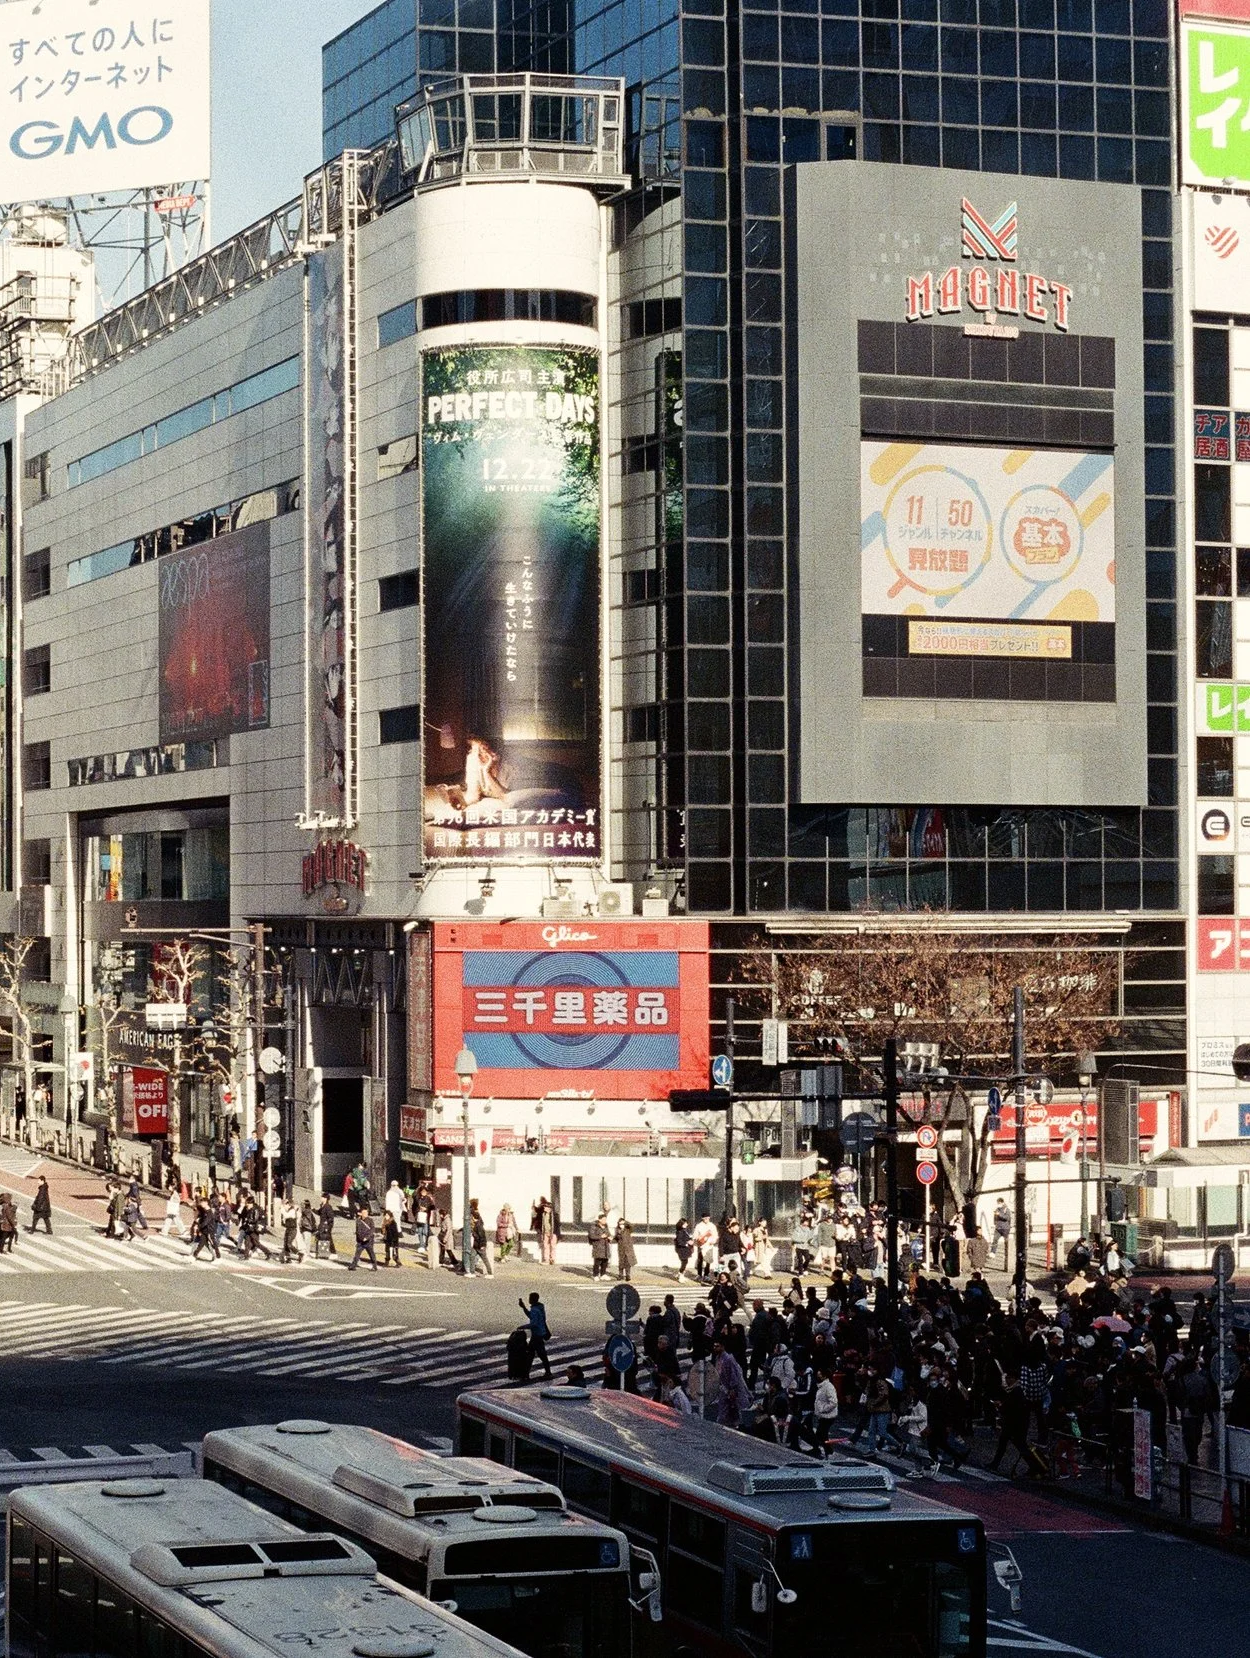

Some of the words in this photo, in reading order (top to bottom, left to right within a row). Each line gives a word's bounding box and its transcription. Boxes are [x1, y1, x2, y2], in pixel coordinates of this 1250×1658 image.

[9, 19, 173, 66] すべての人に
[9, 56, 173, 103] インターネット
[9, 105, 174, 160] GMO
[906, 266, 1073, 333] MAGNET
[466, 370, 533, 386] 役所広司
[427, 391, 538, 424] PERFECT
[546, 392, 596, 424] DAYS
[907, 495, 924, 525] 11
[949, 499, 973, 527] 50
[1021, 522, 1066, 549] 基本
[908, 547, 969, 573] 見放題
[521, 556, 534, 629] こんなふうに
[504, 582, 518, 681] 生きていけたなら
[541, 925, 598, 948] Glico
[473, 991, 669, 1025] 三千里薬品
[119, 1029, 155, 1048] AMERICAN
